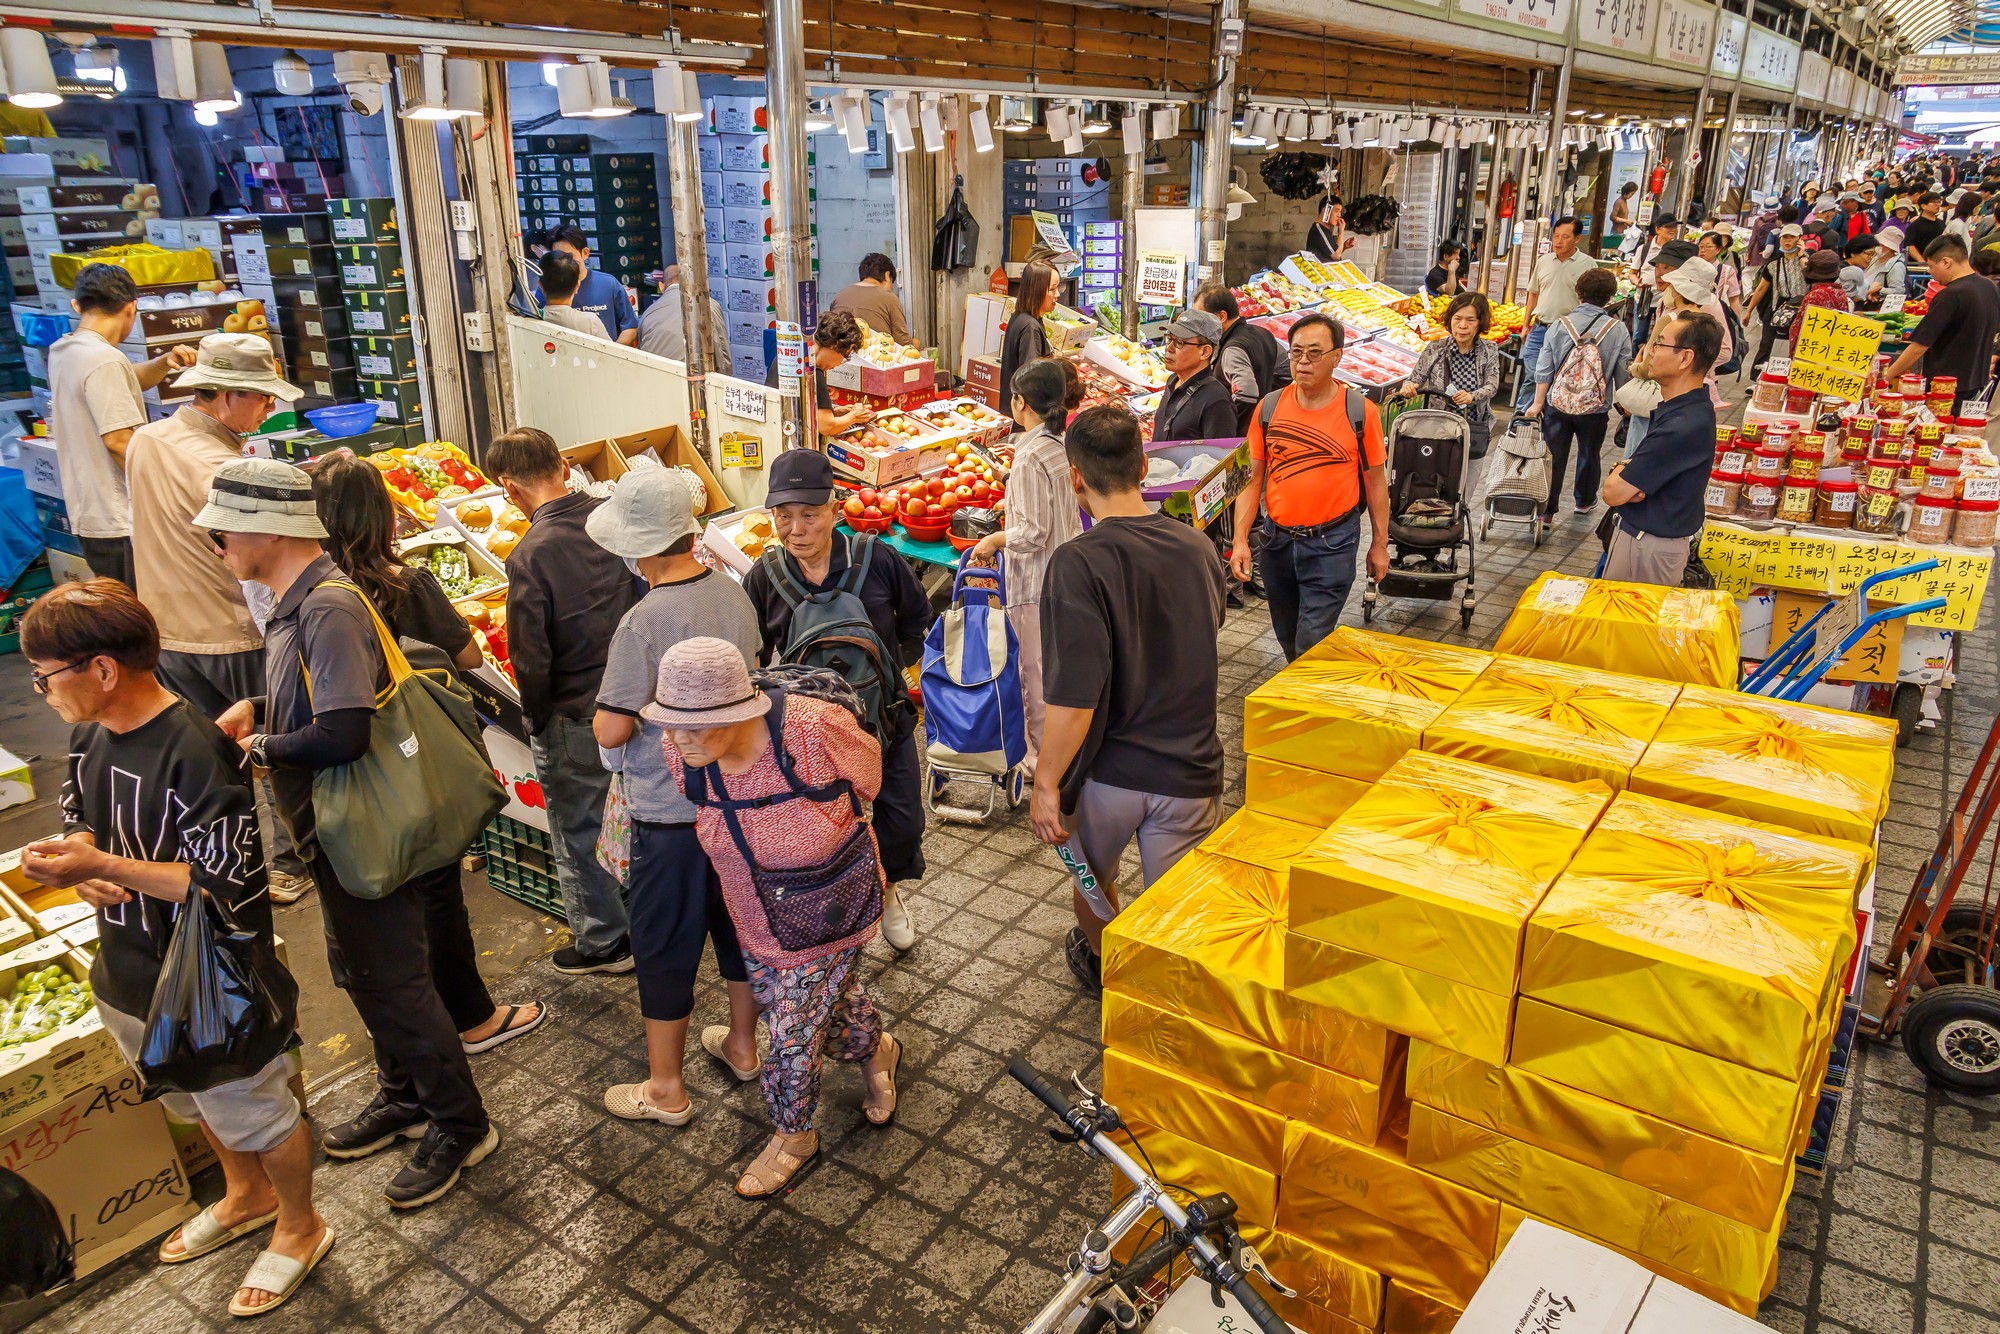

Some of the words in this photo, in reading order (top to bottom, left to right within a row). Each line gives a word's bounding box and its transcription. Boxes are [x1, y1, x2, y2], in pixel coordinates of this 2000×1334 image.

[1144, 266, 1177, 280] 환급행사
[1143, 279, 1177, 292] 참여점포
[582, 304, 607, 312] Project
[1701, 546, 1753, 570] 조개젓
[1847, 545, 1917, 566] 오징어젓
[1784, 564, 1829, 583] 고들빼기
[1925, 580, 1974, 602] 꼴뚜기
[0, 1105, 93, 1172] 고당도
[1531, 1286, 1546, 1306] FRESH
[1518, 1304, 1536, 1329] YEONGJU
